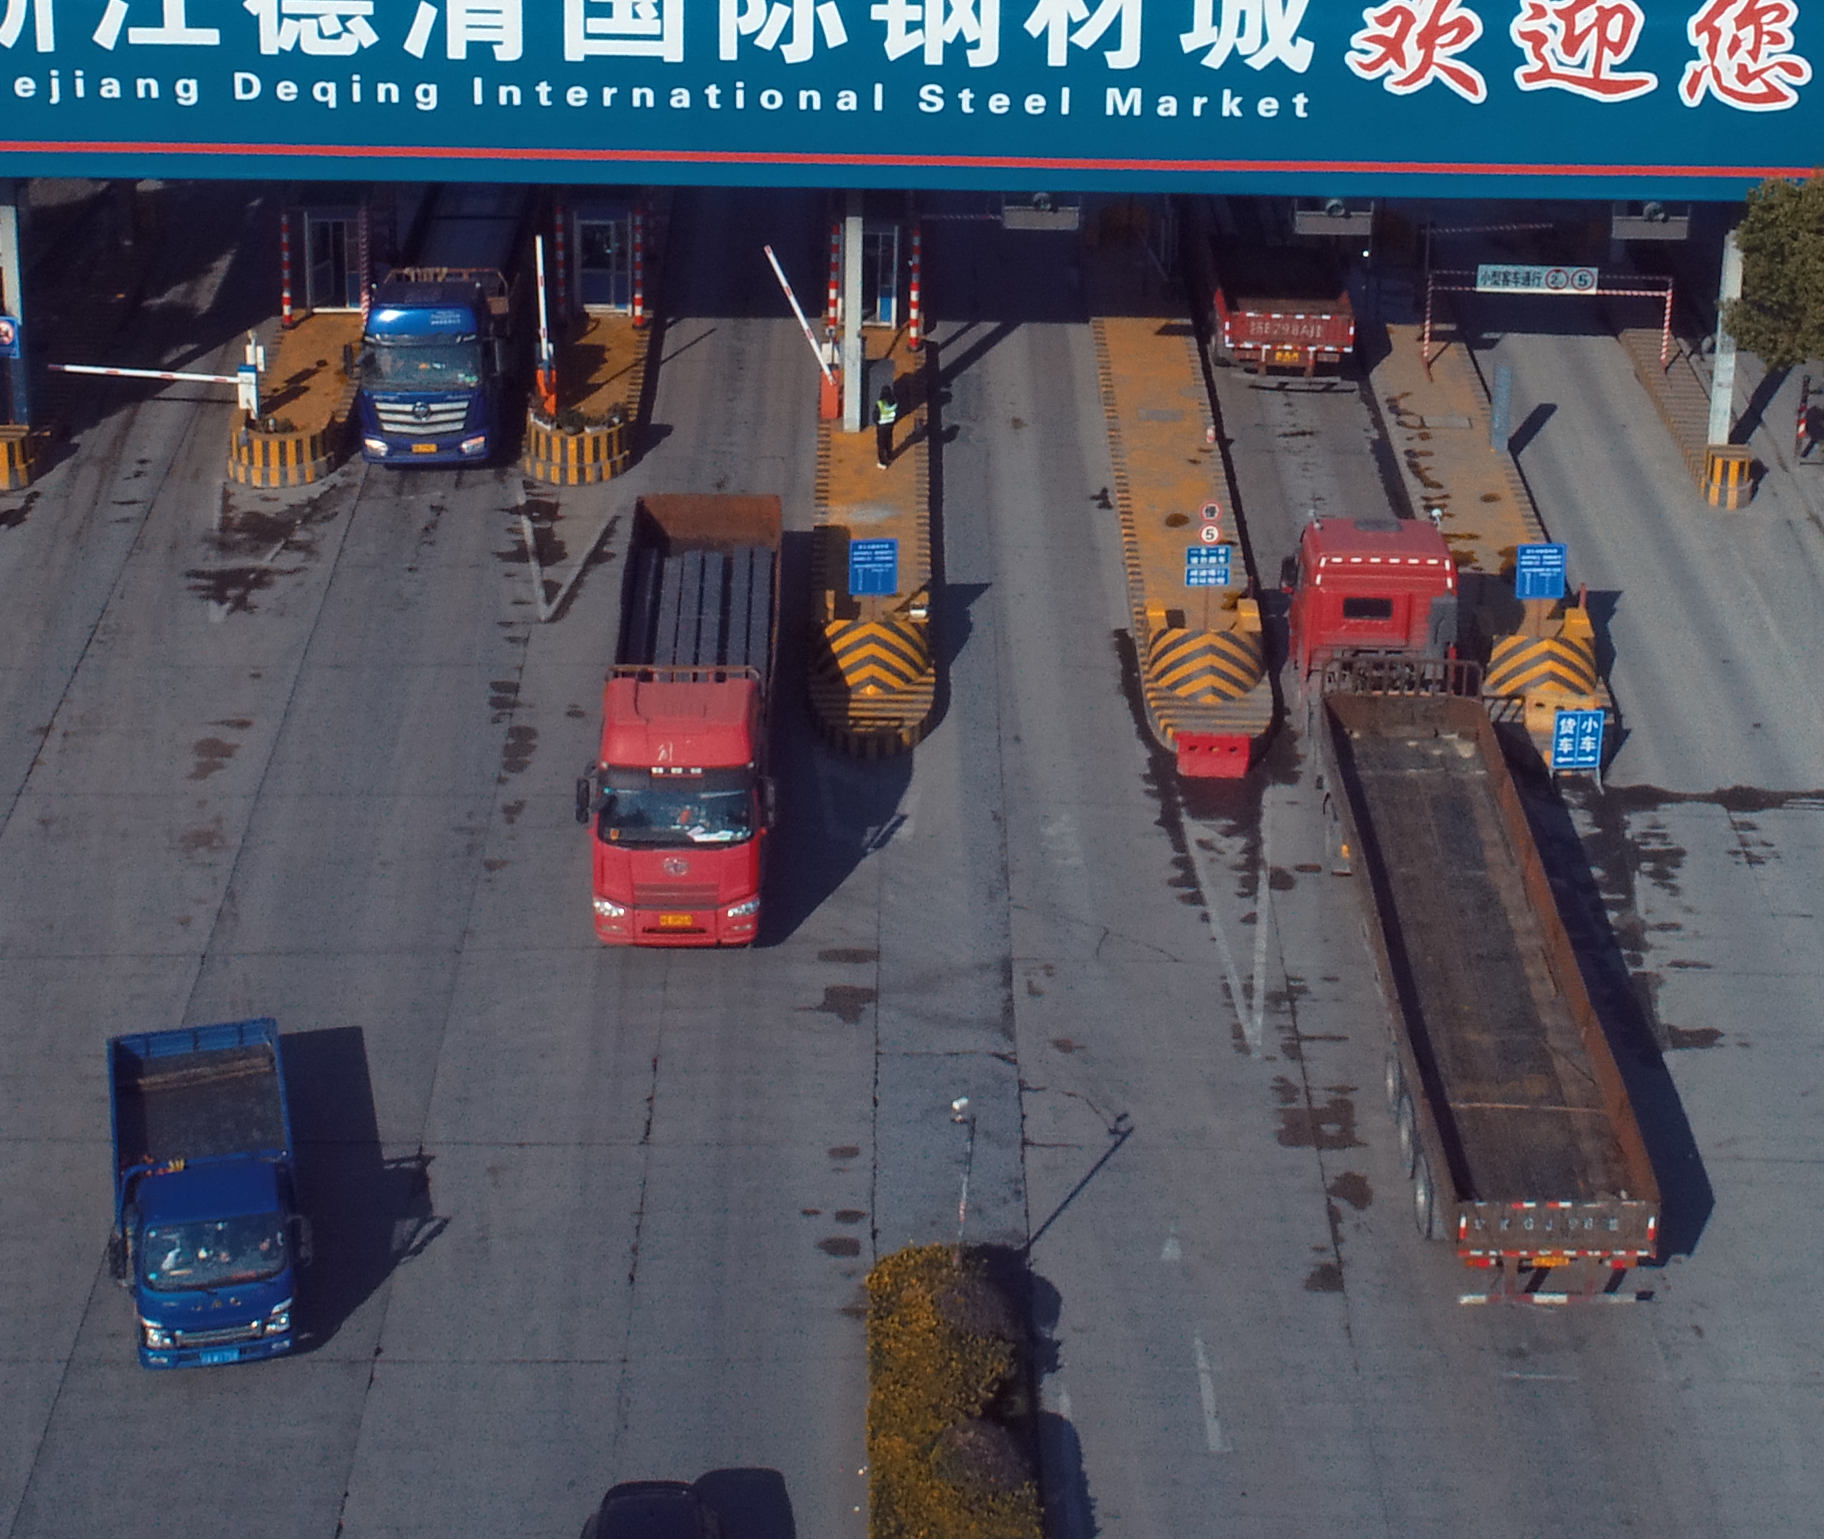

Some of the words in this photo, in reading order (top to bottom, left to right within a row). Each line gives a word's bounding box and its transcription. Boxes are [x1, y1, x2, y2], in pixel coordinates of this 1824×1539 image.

[233, 71, 437, 111] Deqing
[473, 76, 883, 112] International
[918, 83, 1071, 116] Steel
[1105, 87, 1309, 118] Market
[1481, 271, 1542, 287] 小型客车通行
[1556, 717, 1577, 754] 货车
[1579, 716, 1599, 752] 小车
